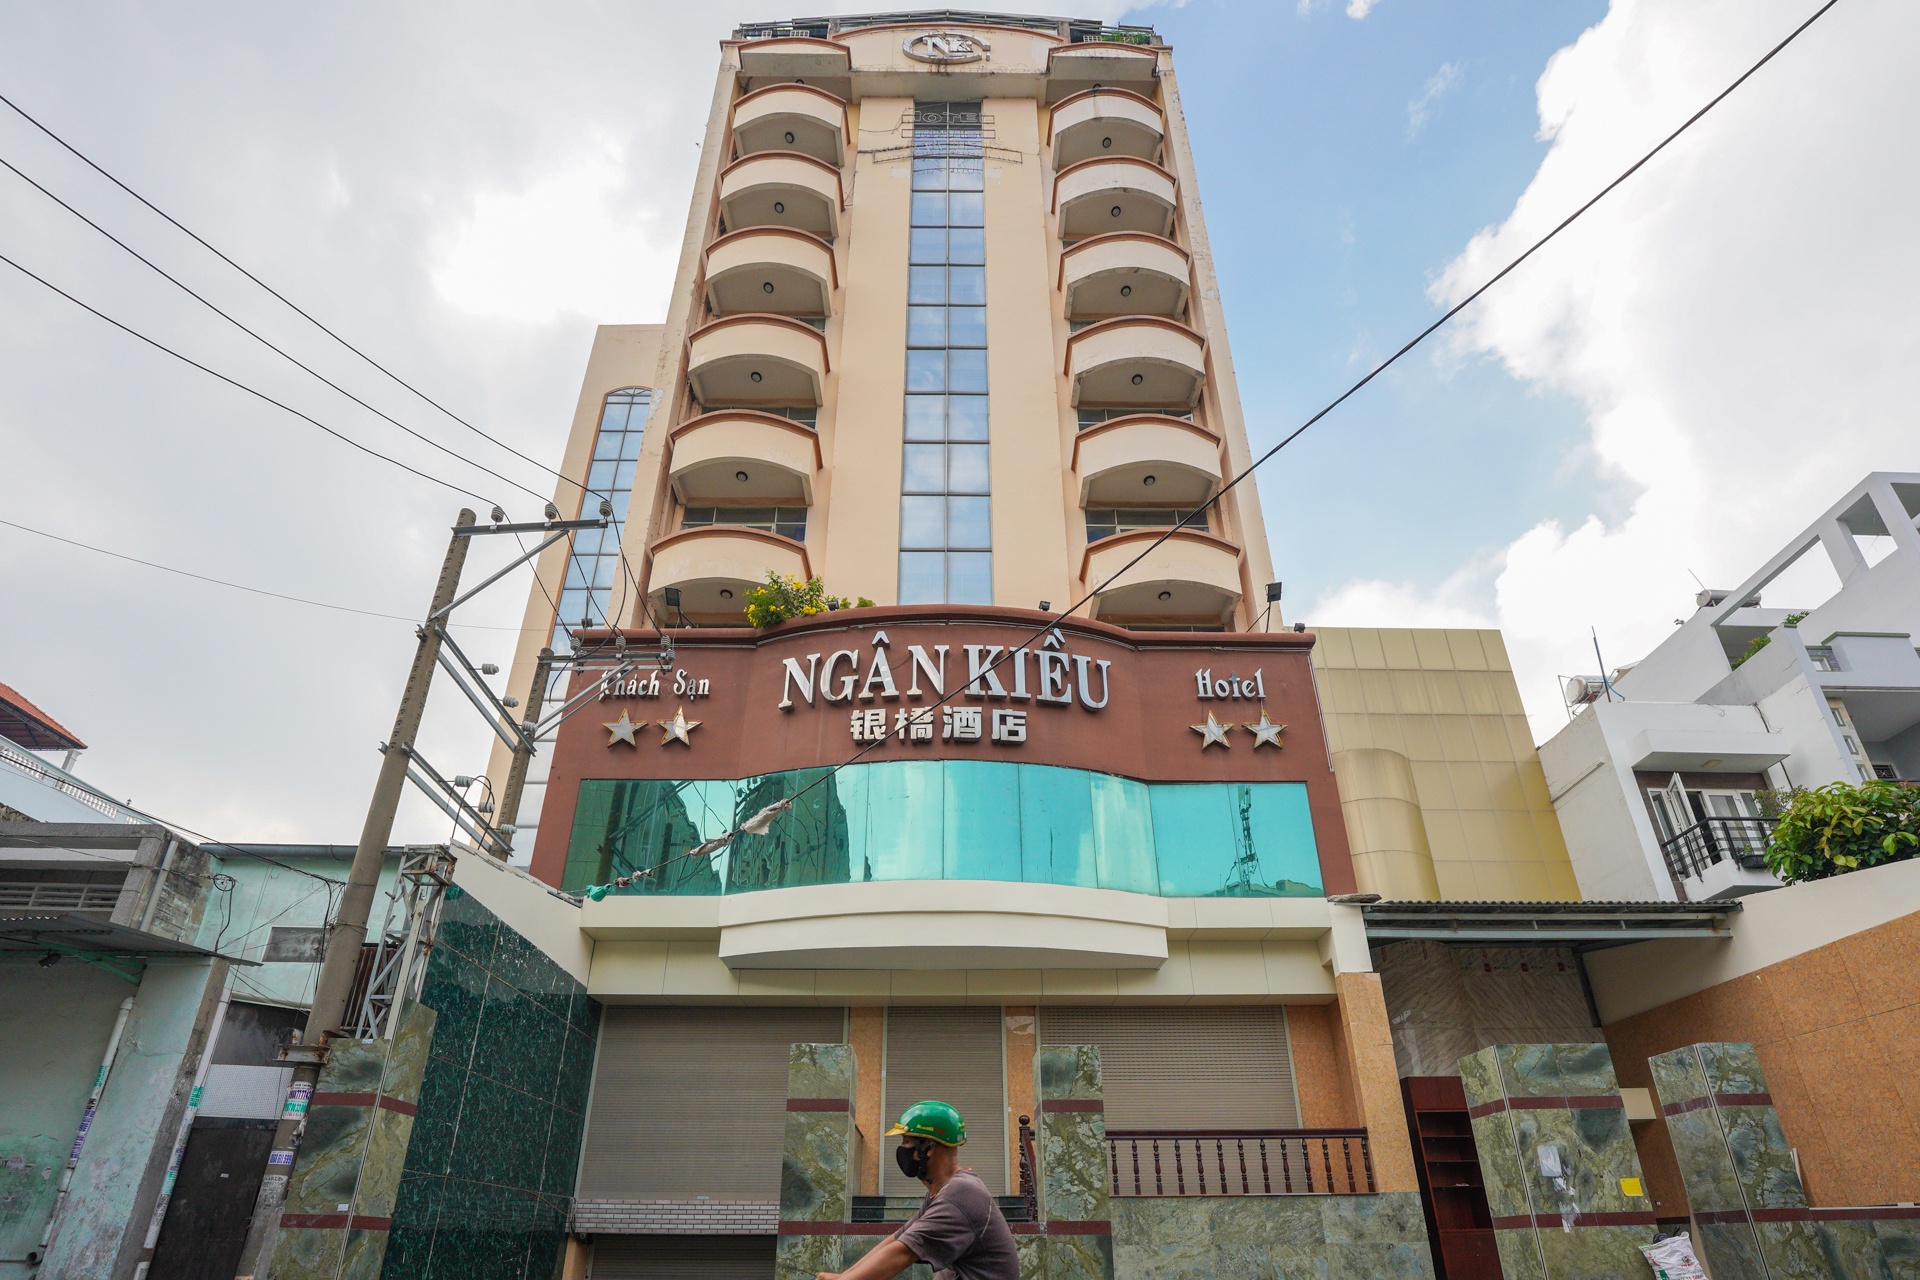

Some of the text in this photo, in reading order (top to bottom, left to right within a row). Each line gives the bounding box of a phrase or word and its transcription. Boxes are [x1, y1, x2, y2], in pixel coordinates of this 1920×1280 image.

[673, 668, 710, 702] Sạn
[777, 628, 1112, 711] NGÂN KIỀU
[1195, 668, 1267, 700] Hotel
